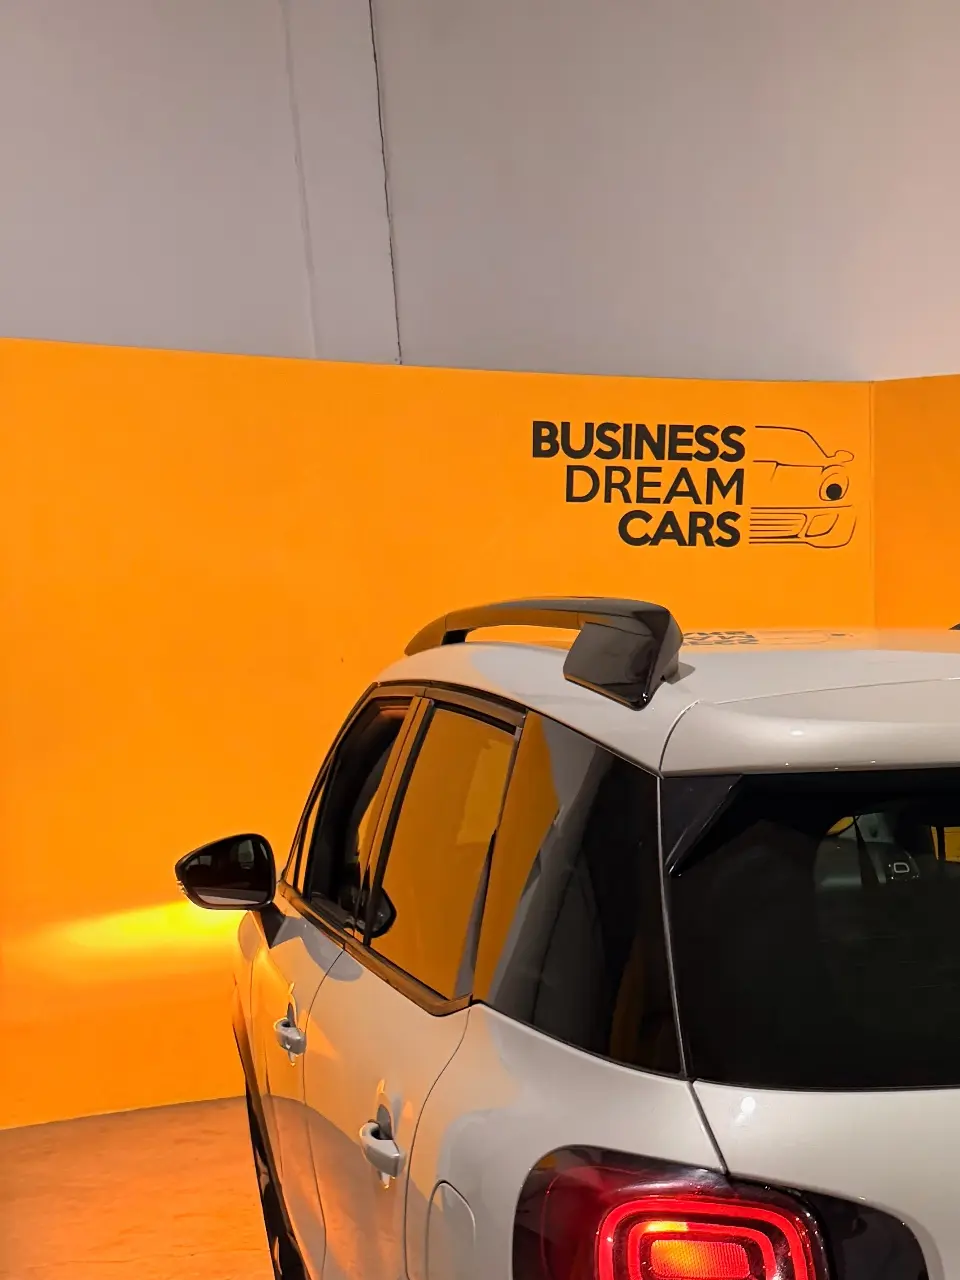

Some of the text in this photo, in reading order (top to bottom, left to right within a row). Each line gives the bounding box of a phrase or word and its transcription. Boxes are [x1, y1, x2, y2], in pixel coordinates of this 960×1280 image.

[532, 420, 746, 462] BUSINESS
[565, 465, 745, 505] DREAM
[618, 509, 741, 548] CARS
